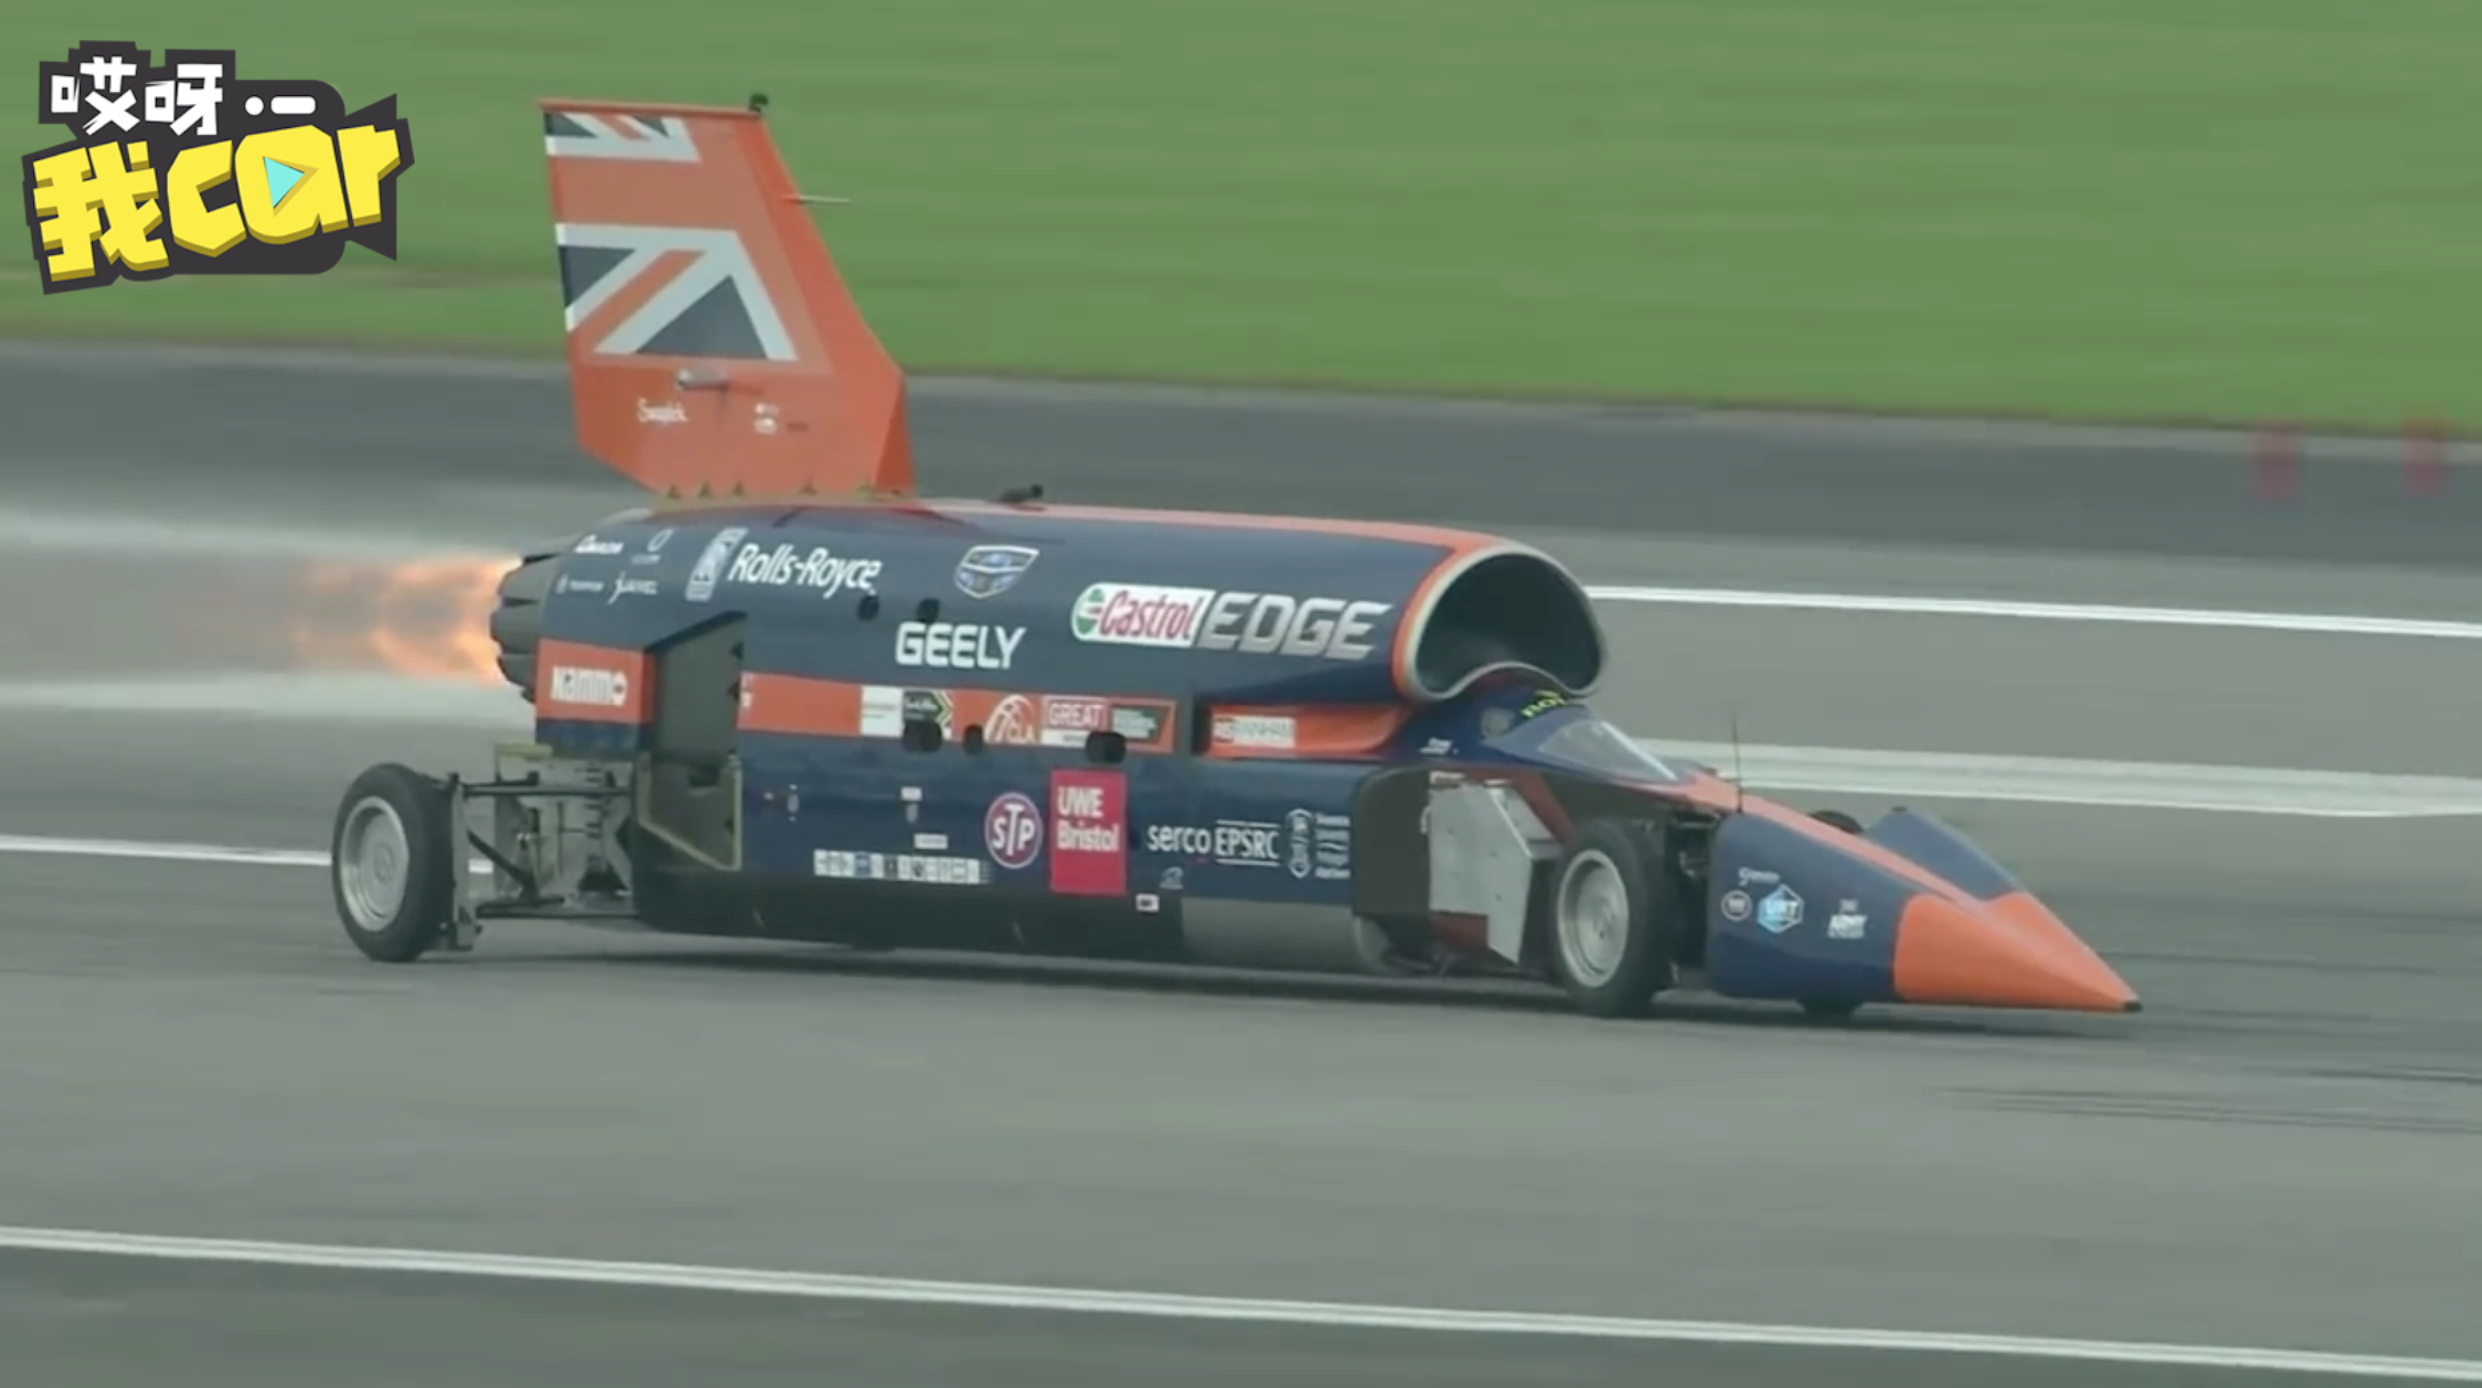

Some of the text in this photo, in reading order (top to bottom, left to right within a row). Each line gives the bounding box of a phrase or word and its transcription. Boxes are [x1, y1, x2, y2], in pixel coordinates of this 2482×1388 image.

[727, 542, 883, 600] Rolls-Royce
[1100, 588, 1394, 661] Castrol EDGE
[895, 621, 1027, 669] GEELY
[1050, 702, 1104, 729] GREAT
[1057, 786, 1104, 818] UWE
[992, 803, 1036, 856] STP
[1056, 821, 1120, 851] Bristol
[1147, 824, 1212, 853] serco
[1214, 827, 1281, 859] EPSRC
